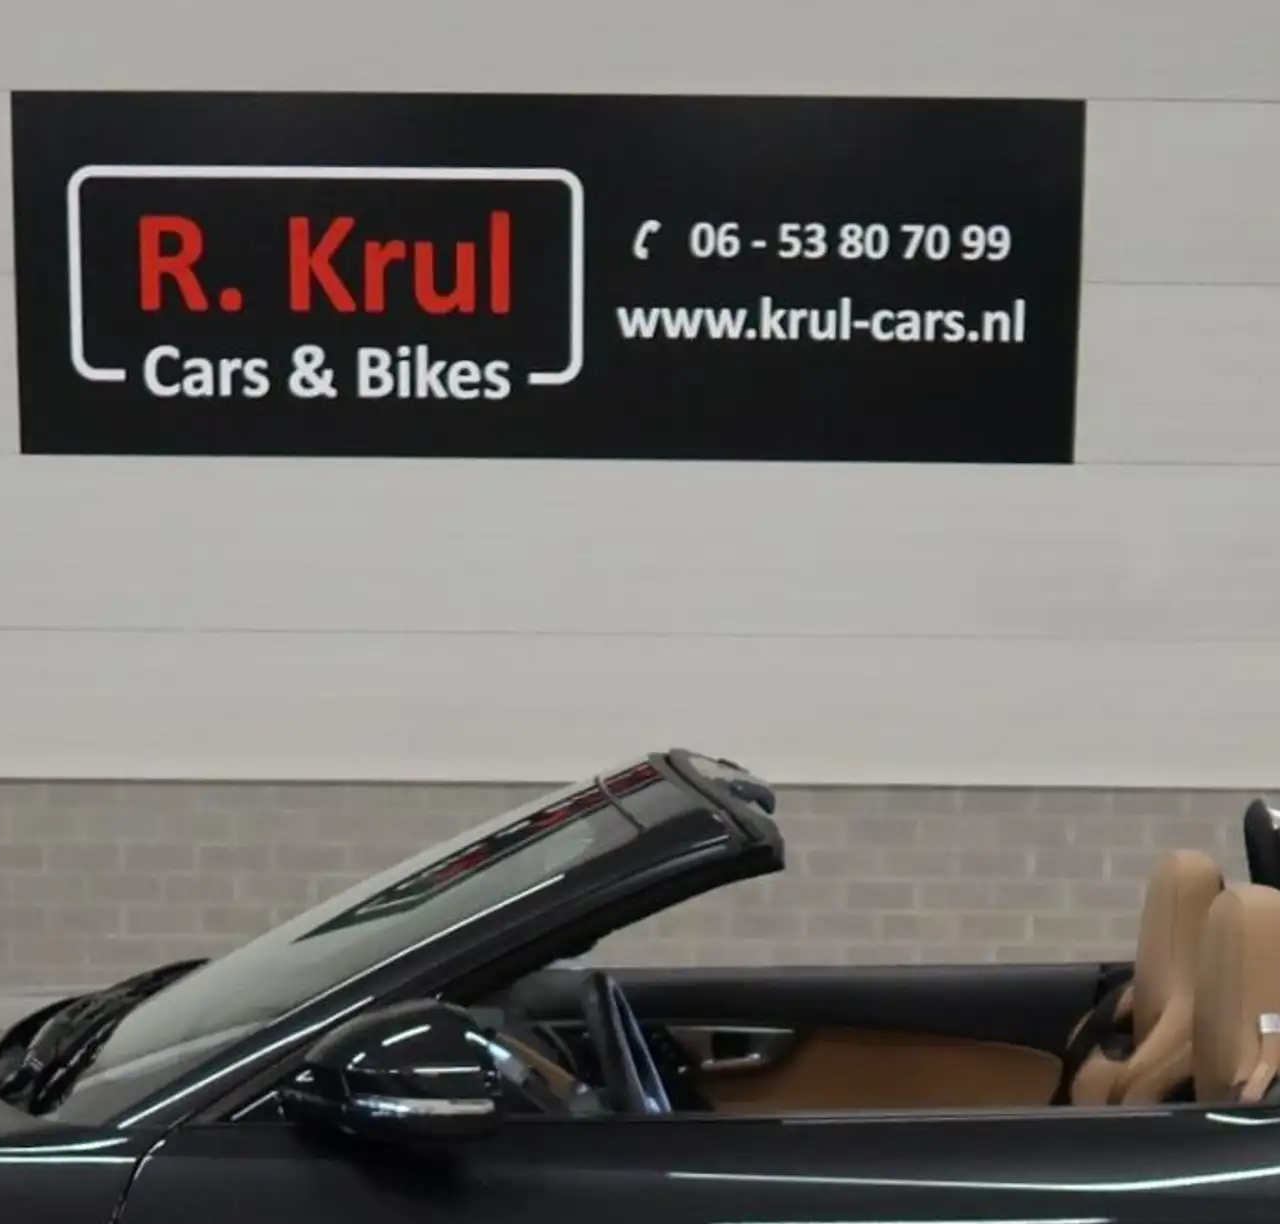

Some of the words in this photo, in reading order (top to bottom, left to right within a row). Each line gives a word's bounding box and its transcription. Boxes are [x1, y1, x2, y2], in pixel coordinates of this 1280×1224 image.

[139, 215, 243, 312] R.
[289, 210, 511, 314] Krul
[690, 221, 741, 258] 06
[751, 240, 767, 248] -
[778, 222, 828, 259] 53
[838, 223, 890, 260] 80
[901, 224, 950, 260] 70
[961, 224, 1011, 261] 99
[616, 296, 1026, 343] www.krul-cars.nl
[143, 344, 270, 398] Cars
[288, 344, 338, 399] &
[357, 344, 511, 400] Bikes
